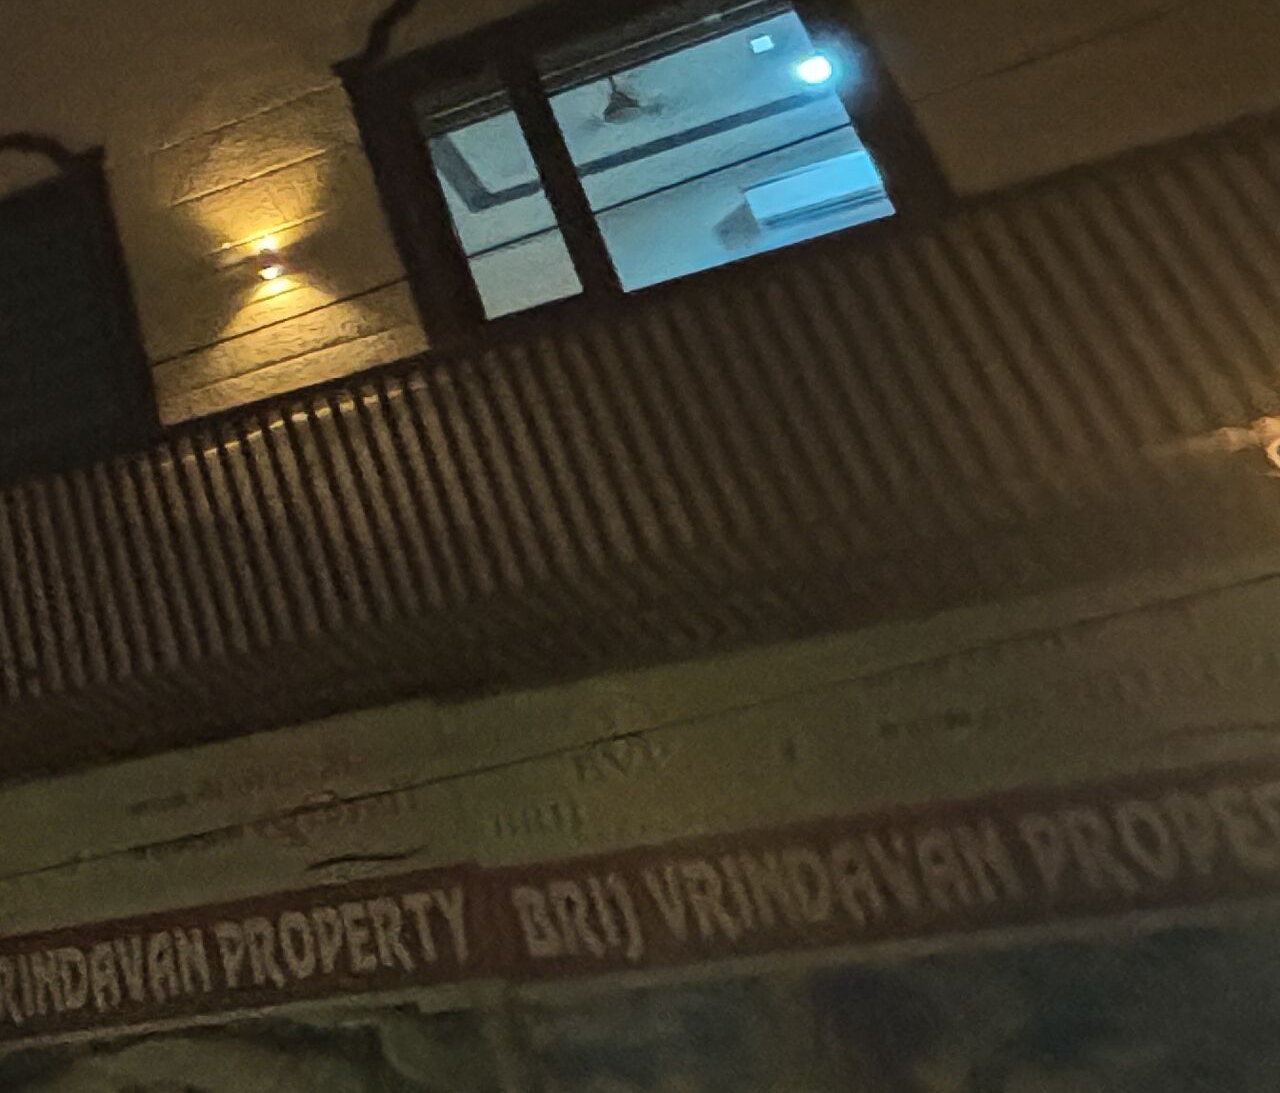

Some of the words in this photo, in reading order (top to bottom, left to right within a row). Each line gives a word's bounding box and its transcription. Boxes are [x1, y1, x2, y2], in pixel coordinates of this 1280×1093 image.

[215, 885, 468, 989] PROPERTY
[512, 872, 642, 959] BRIJ
[643, 818, 1024, 943] VRINDAVAN
[1017, 784, 1280, 895] PROPE
